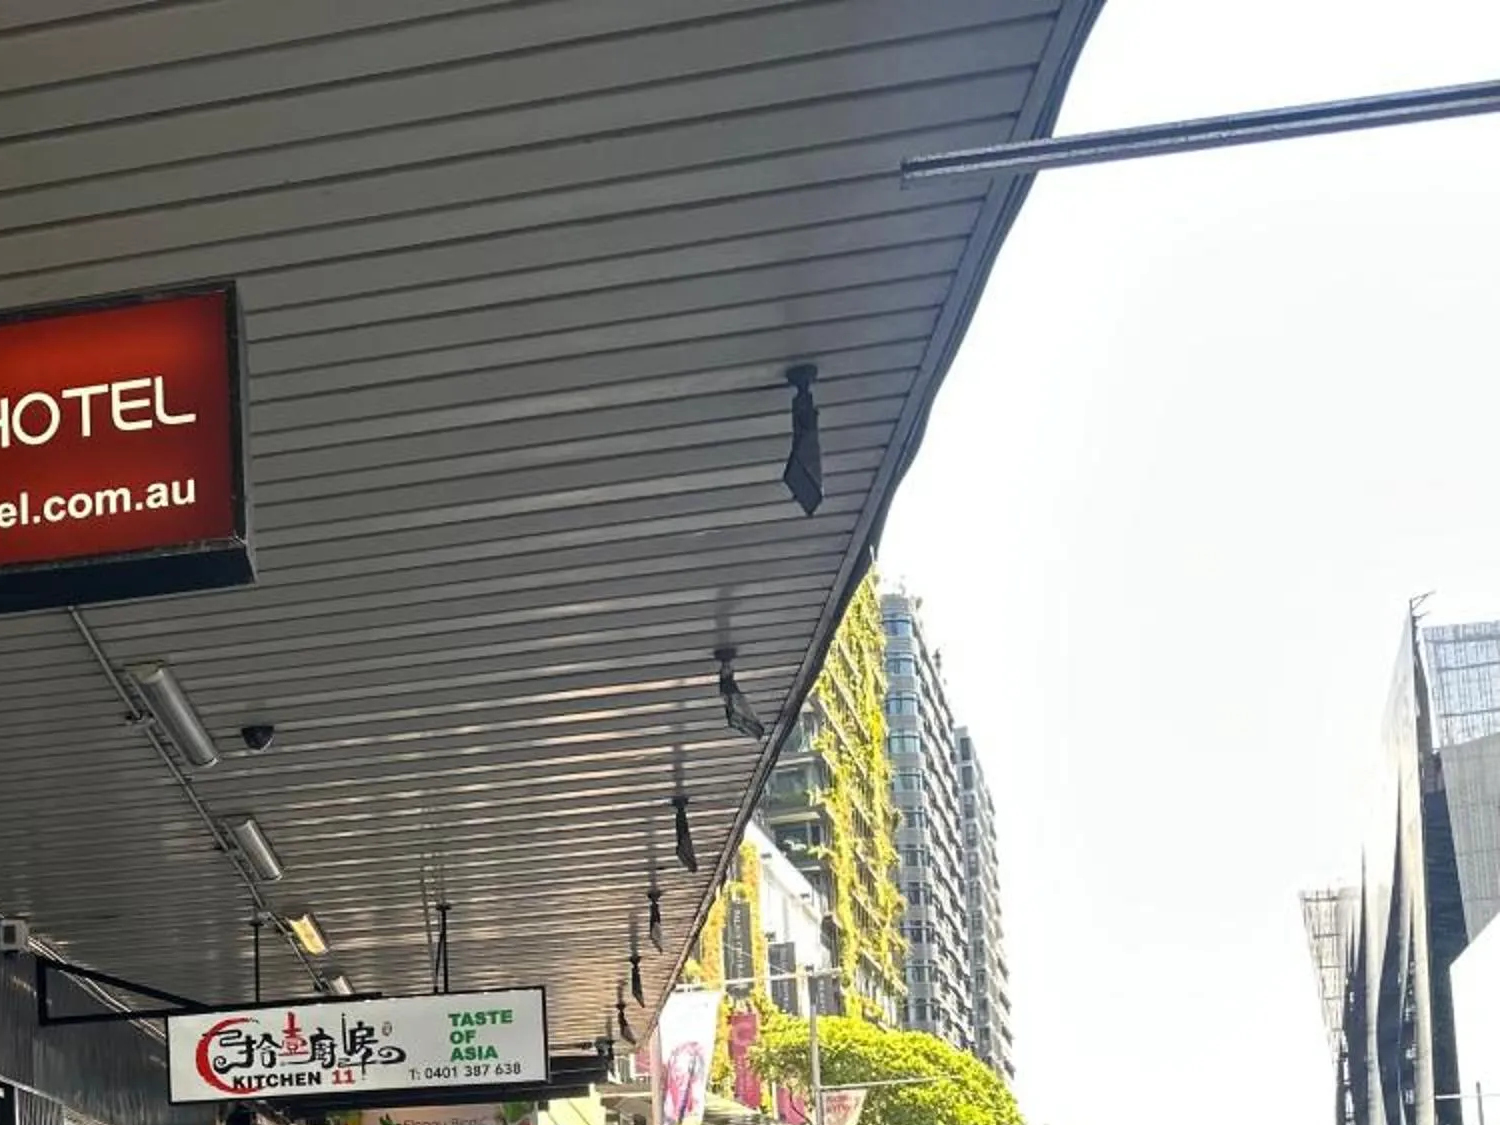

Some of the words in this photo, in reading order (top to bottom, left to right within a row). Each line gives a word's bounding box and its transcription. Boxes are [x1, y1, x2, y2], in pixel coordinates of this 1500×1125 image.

[448, 1009, 514, 1027] TASTE
[449, 1029, 477, 1046] OF
[450, 1045, 499, 1063] ASIA
[232, 1071, 322, 1090] KITCHEN
[330, 1069, 357, 1085] 11
[423, 1066, 459, 1081] 0401
[464, 1064, 490, 1078] 387
[494, 1063, 522, 1076] 638
